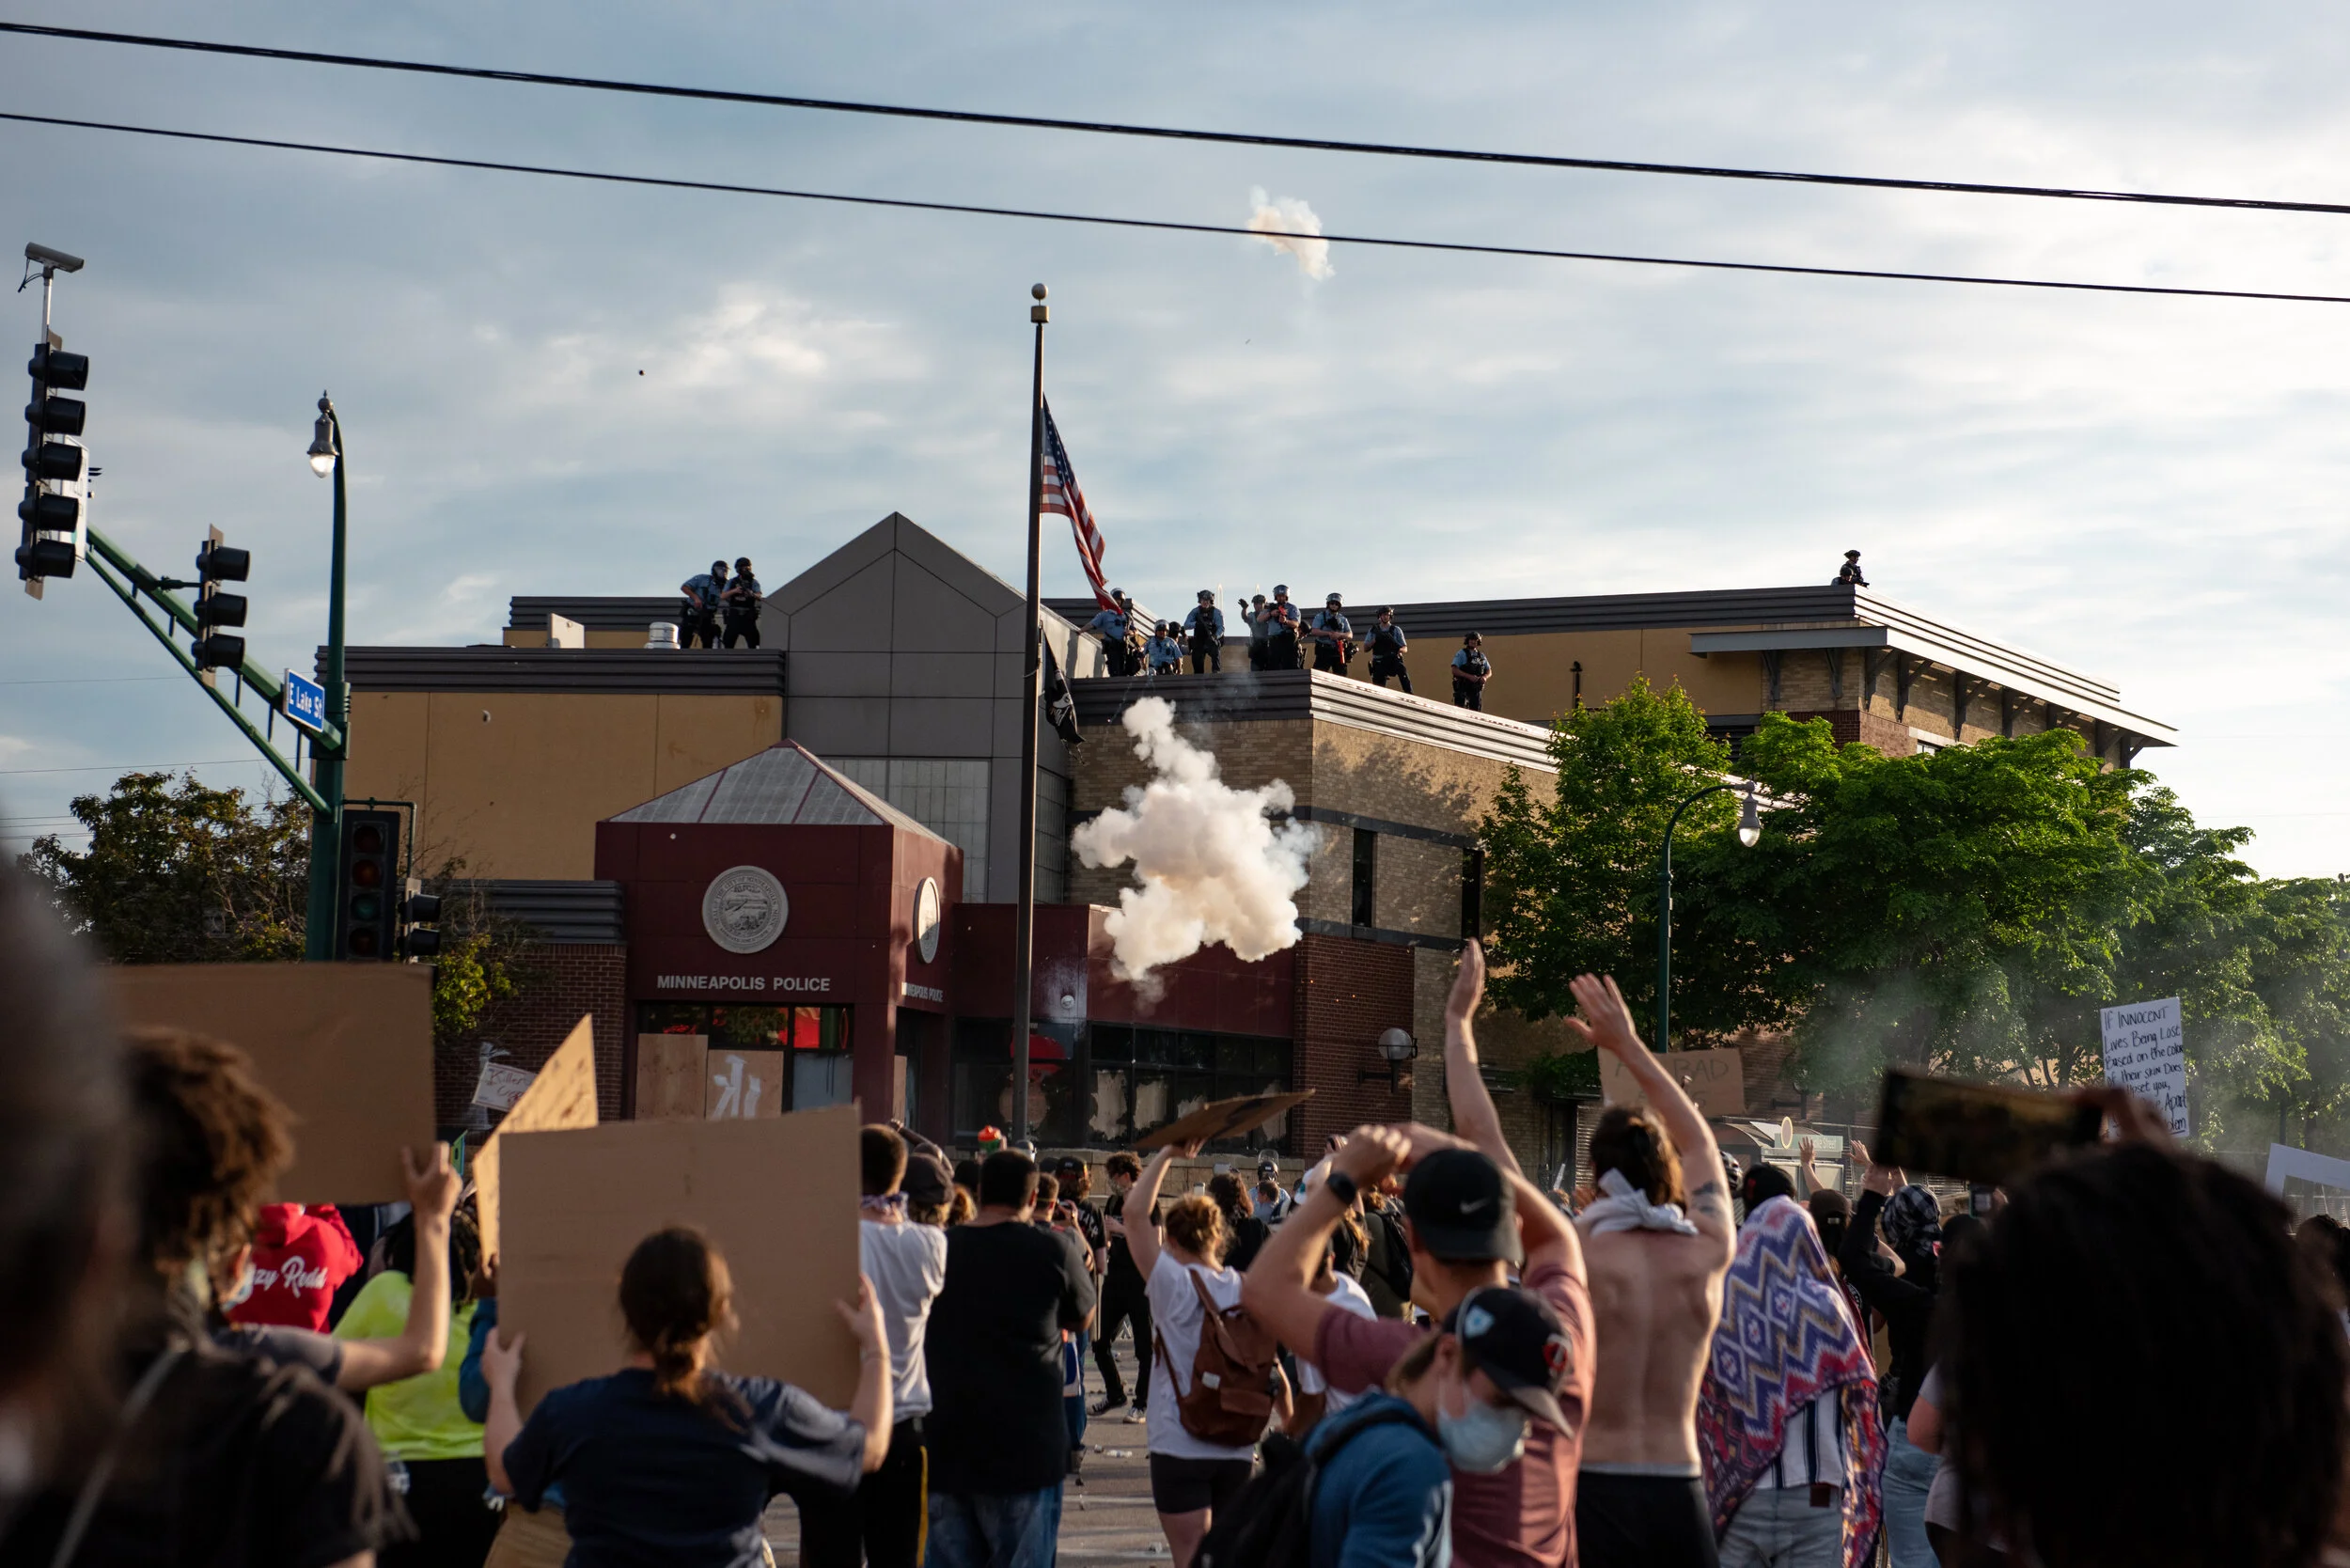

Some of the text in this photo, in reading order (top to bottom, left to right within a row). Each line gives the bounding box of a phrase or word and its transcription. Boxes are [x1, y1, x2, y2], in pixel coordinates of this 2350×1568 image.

[289, 682, 322, 719] E Lake St
[657, 975, 831, 992] MINNEAPOLIS POLICE
[2104, 1025, 2181, 1055] Lives Being Lost
[1673, 1058, 1729, 1082] BAD
[2105, 1053, 2132, 1071] Based
[2136, 1052, 2148, 1062] on
[2150, 1047, 2166, 1060] the
